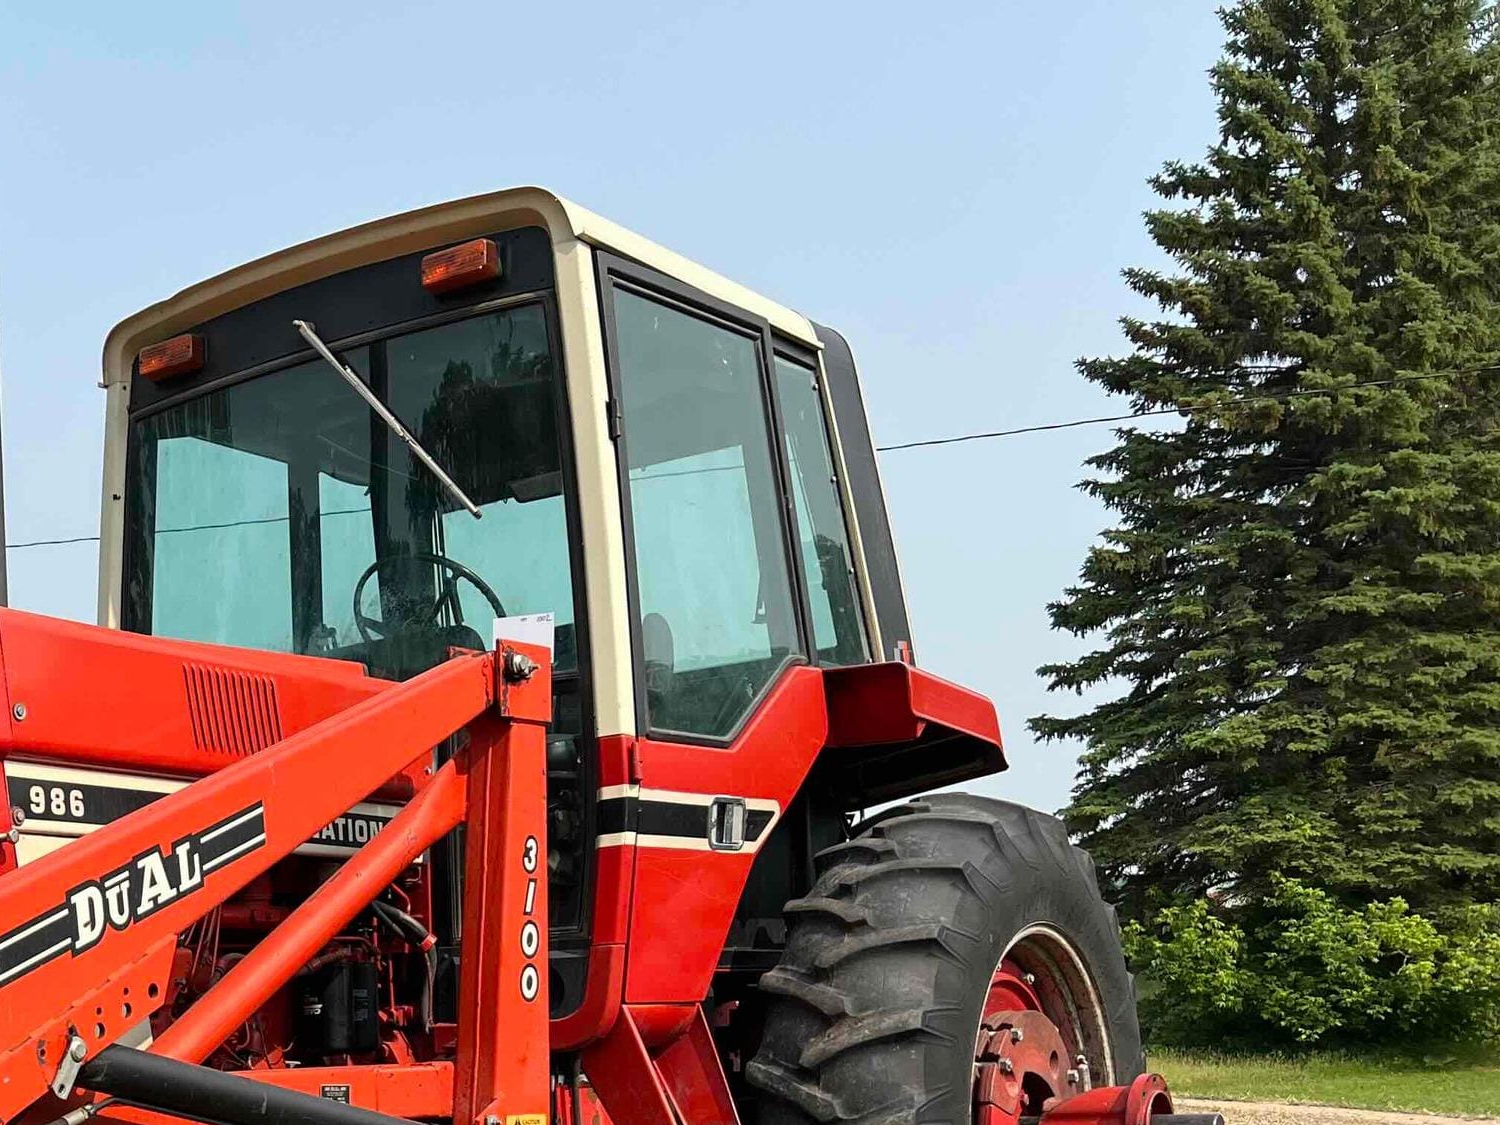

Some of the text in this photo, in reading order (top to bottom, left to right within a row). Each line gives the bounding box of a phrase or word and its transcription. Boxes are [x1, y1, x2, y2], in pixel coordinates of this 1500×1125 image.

[29, 785, 85, 817] 986
[312, 817, 383, 843] ATION
[520, 837, 540, 1002] 3100
